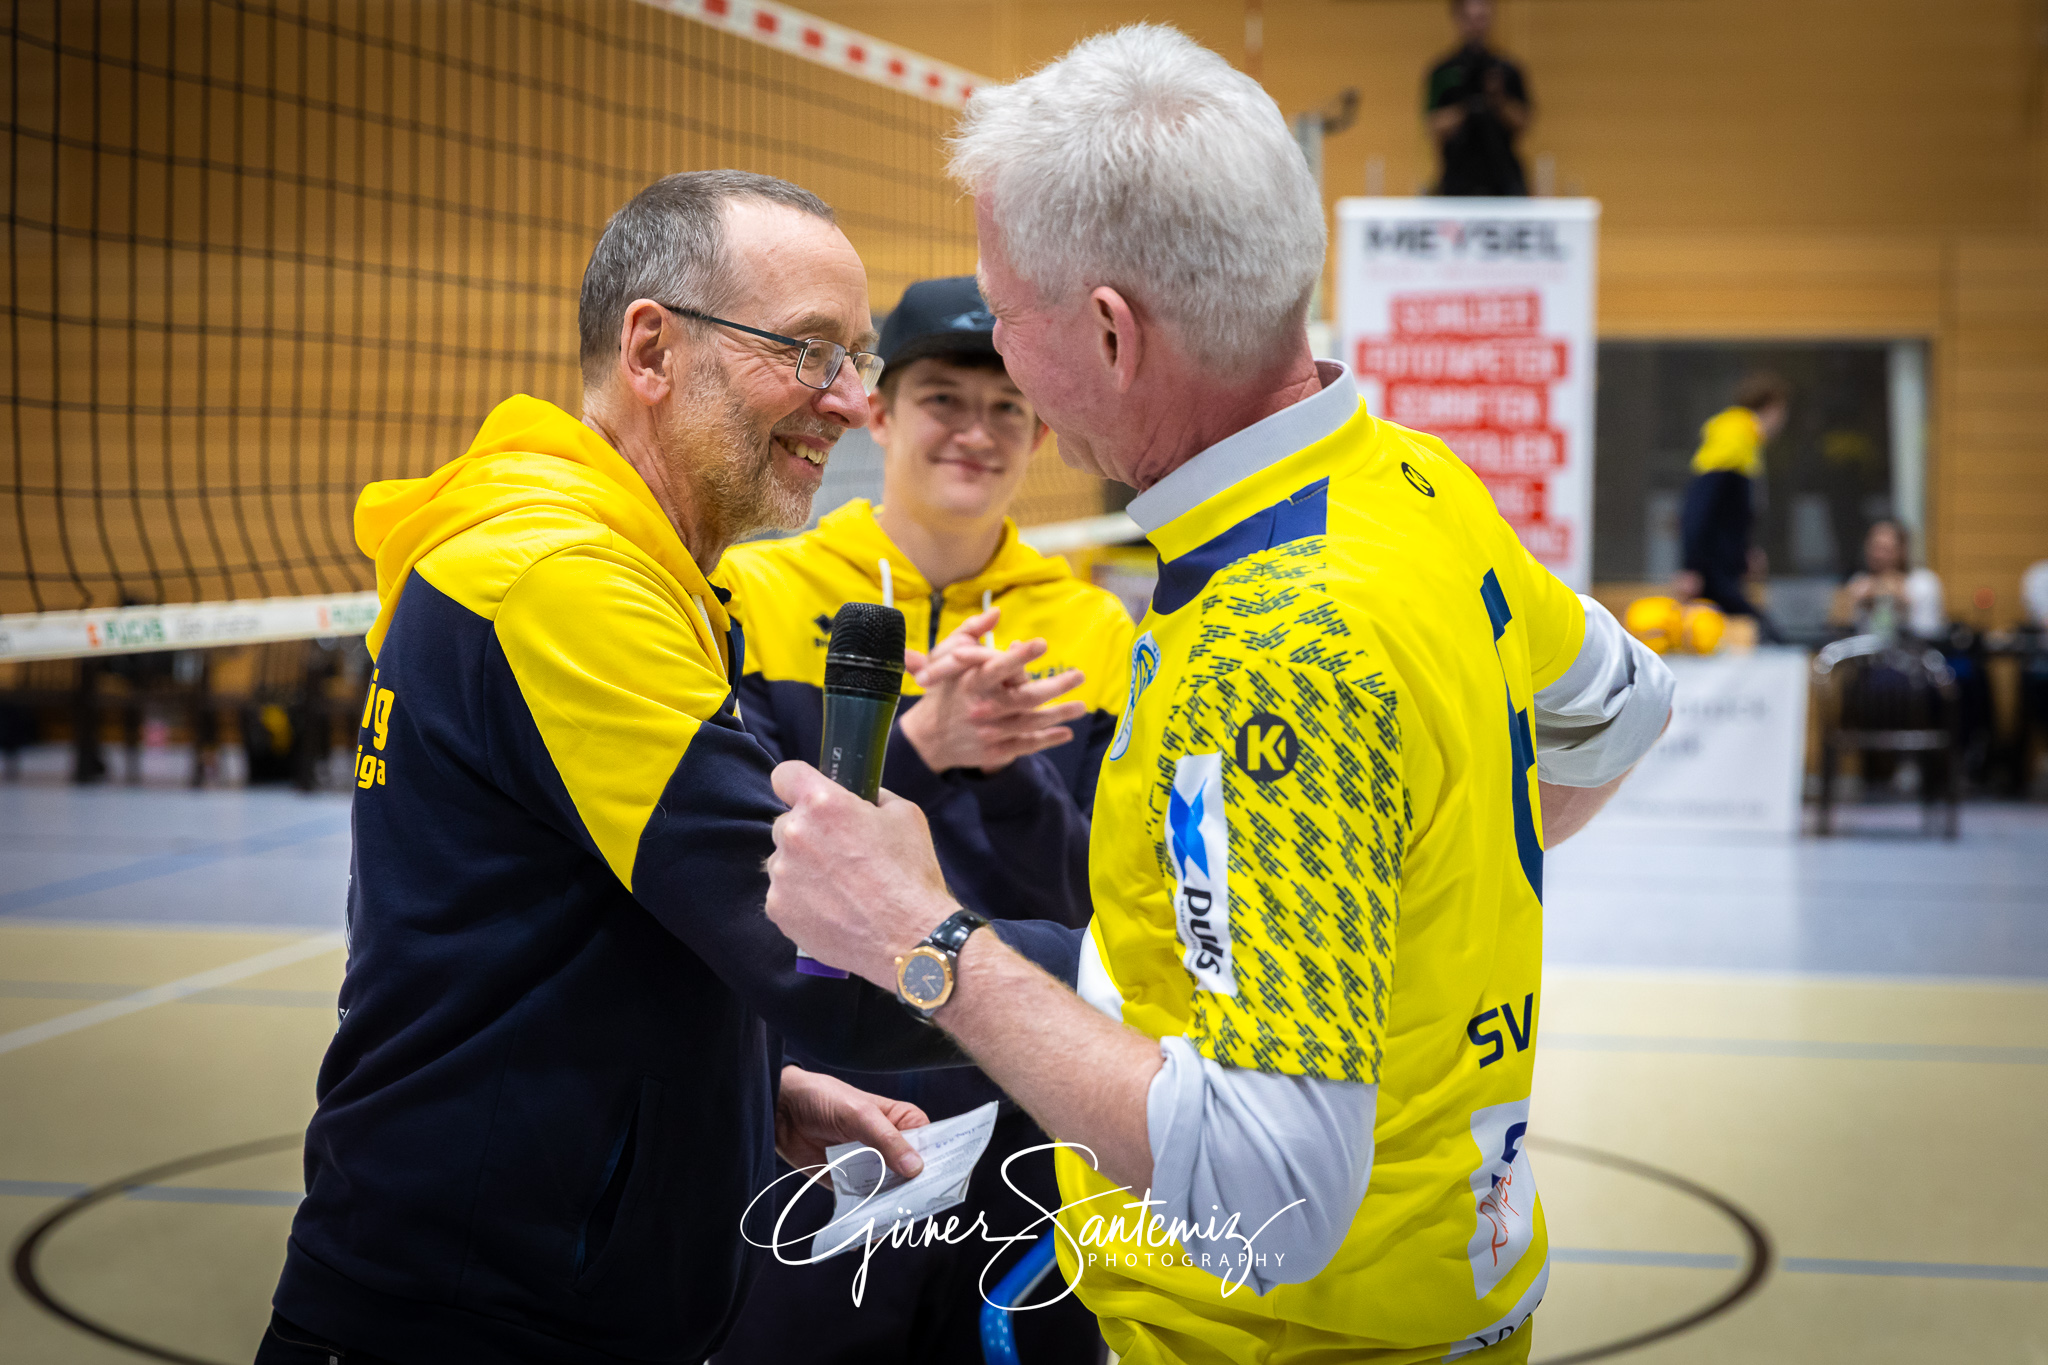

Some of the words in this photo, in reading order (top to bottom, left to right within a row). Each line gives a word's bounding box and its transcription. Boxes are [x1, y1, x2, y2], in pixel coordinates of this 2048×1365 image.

[1363, 220, 1568, 259] MEYSEL
[361, 668, 395, 751] ig
[354, 744, 386, 789] iga
[1183, 886, 1224, 974] puls
[1467, 992, 1534, 1069] SV
